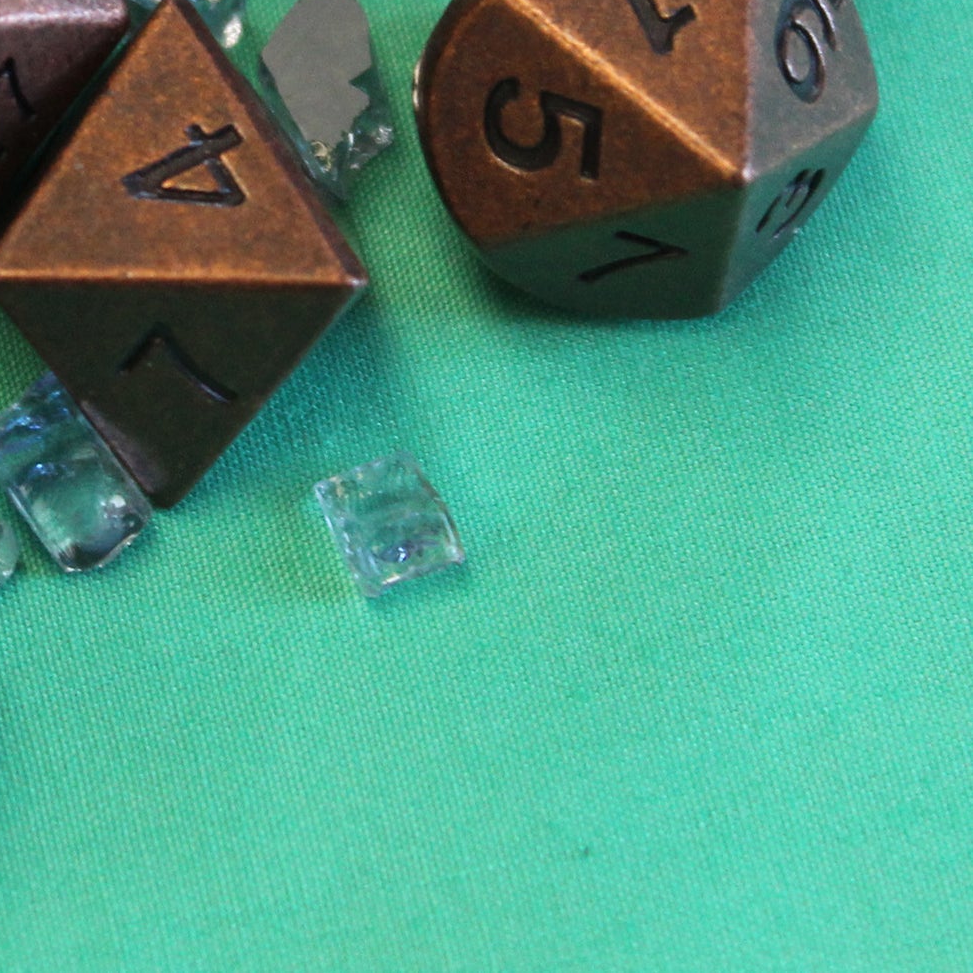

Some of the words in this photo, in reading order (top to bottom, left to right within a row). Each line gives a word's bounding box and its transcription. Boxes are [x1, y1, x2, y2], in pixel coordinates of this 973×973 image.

[121, 122, 247, 208] 4
[483, 76, 605, 181] 5
[576, 230, 689, 286] 7
[118, 323, 239, 406] 7
